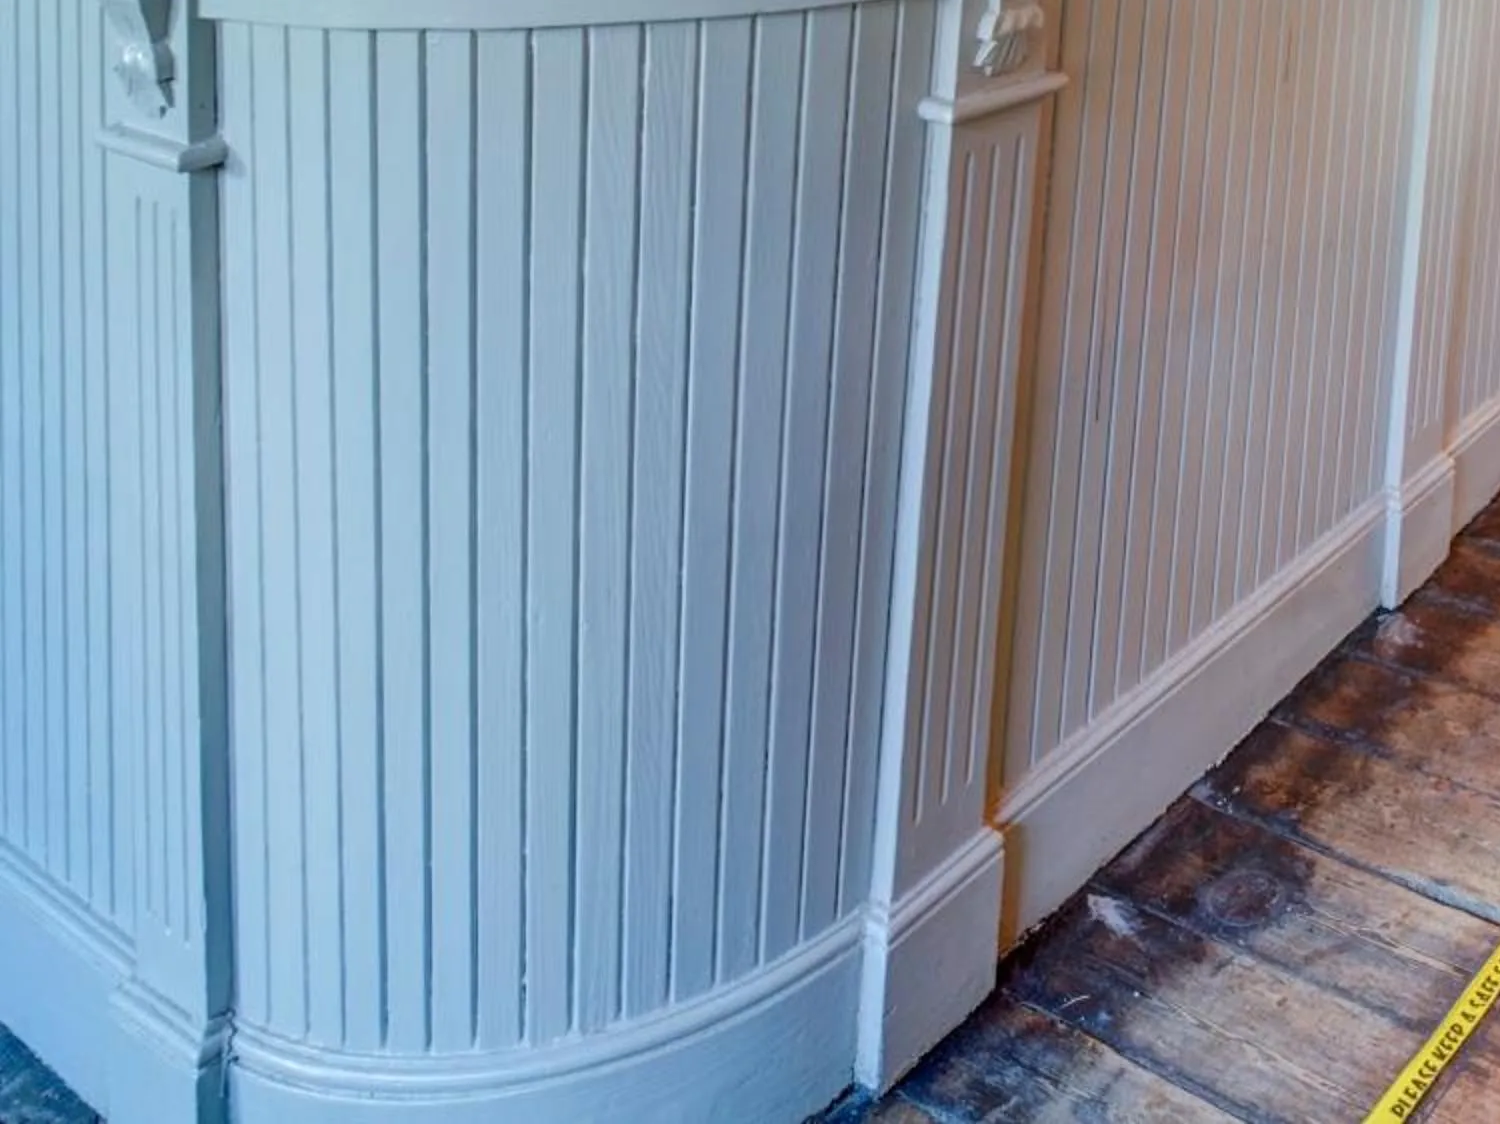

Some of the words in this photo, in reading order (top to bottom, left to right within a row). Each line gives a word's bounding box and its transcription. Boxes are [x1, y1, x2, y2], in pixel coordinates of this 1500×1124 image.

[1390, 1059, 1438, 1119] PLEASE
[1431, 1022, 1465, 1062] KEEP
[1460, 1010, 1477, 1023] A
